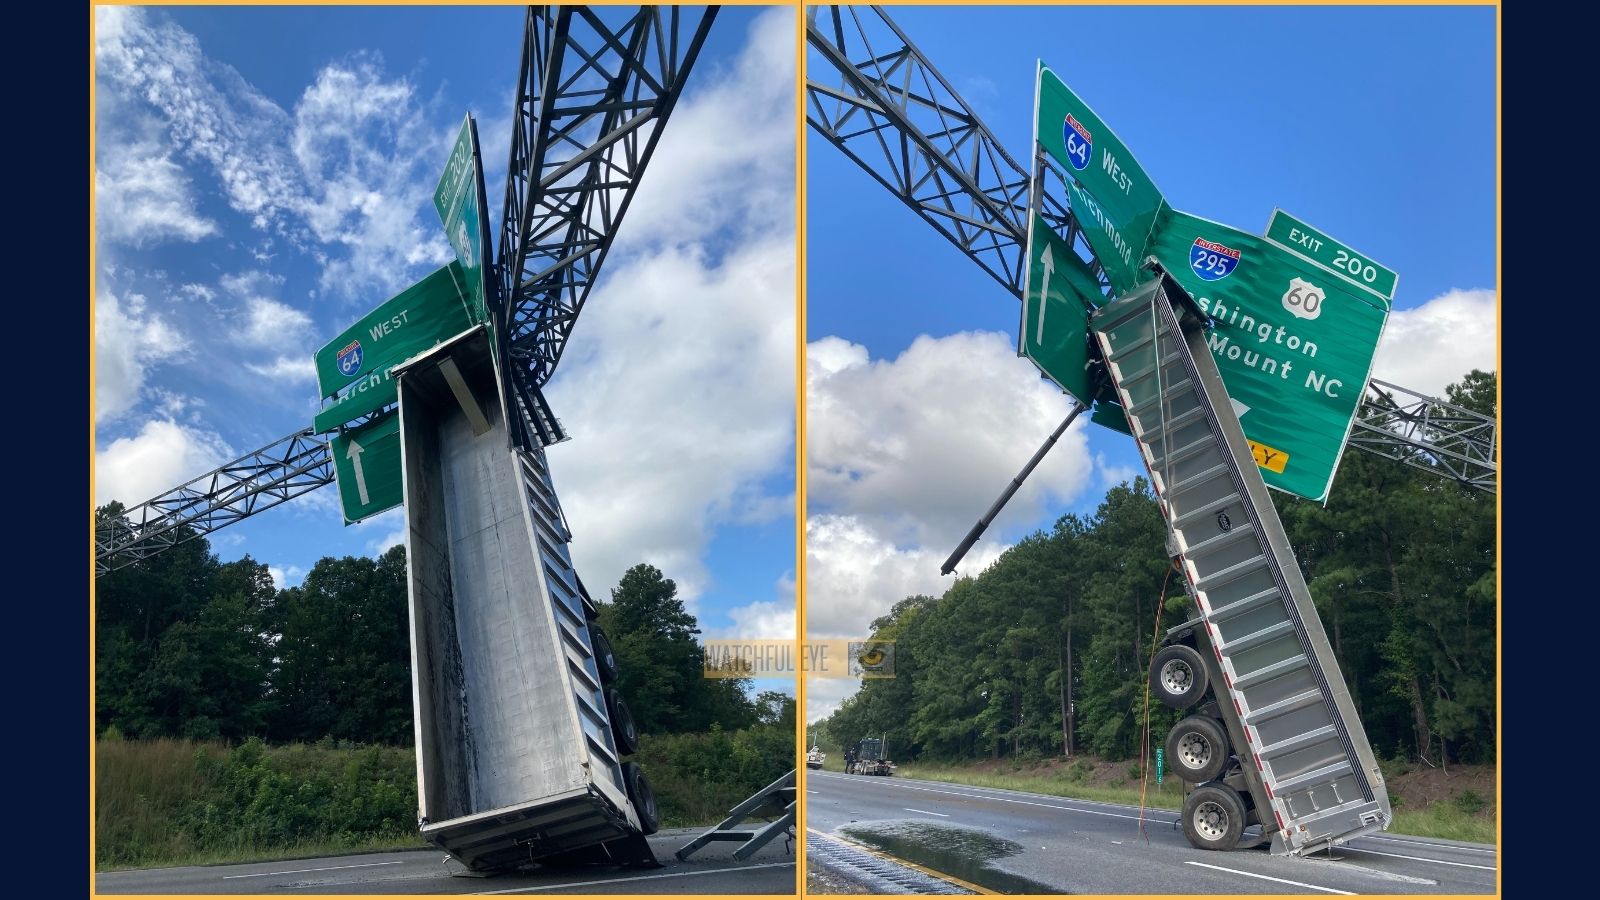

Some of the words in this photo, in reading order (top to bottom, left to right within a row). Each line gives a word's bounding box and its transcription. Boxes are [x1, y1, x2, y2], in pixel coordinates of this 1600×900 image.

[1067, 132, 1087, 164] 64
[440, 182, 451, 209] EXIT
[450, 140, 465, 184] 200
[1102, 147, 1133, 196] WEST
[1193, 250, 1229, 276] 295
[1198, 240, 1237, 258] INTERSTATE
[1288, 228, 1323, 253] EXIT
[1332, 250, 1377, 283] 200
[1287, 286, 1320, 313] 60
[368, 309, 409, 342] WEST
[1187, 291, 1318, 358] shington
[342, 350, 360, 372] 64
[1208, 332, 1293, 380] Mount
[1304, 370, 1343, 398] NC
